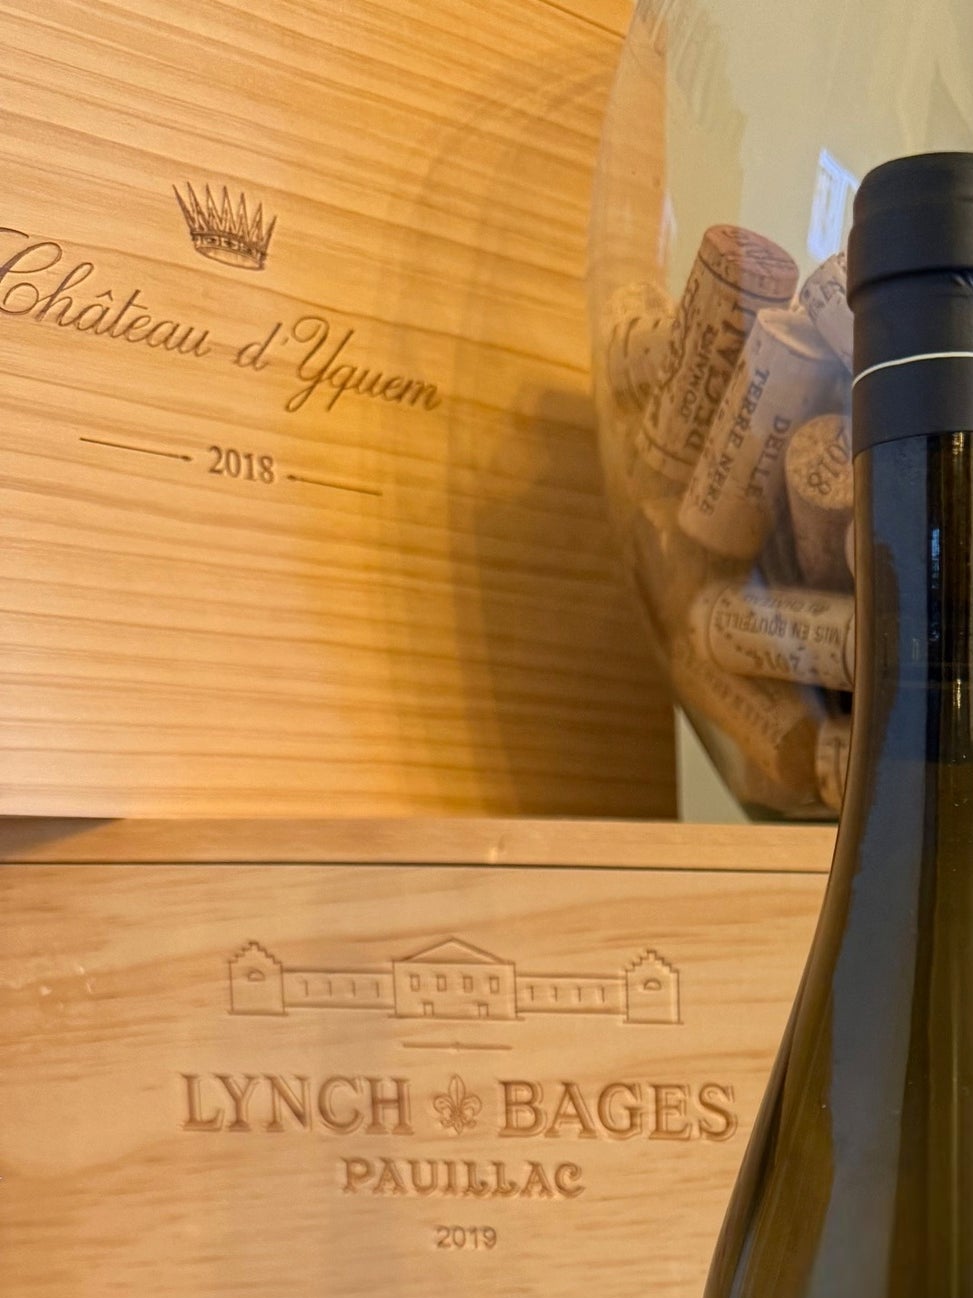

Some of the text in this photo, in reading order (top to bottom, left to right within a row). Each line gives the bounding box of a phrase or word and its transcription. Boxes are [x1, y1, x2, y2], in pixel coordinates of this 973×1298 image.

[0, 226, 443, 413] Château d'Yquem
[729, 367, 771, 450] TERRE
[207, 444, 276, 485] 2018
[744, 414, 793, 498] DELLE
[179, 1072, 739, 1143] LYNCH BAGES
[339, 1155, 588, 1200] PAUILLAC
[435, 1225, 499, 1251] 2019
